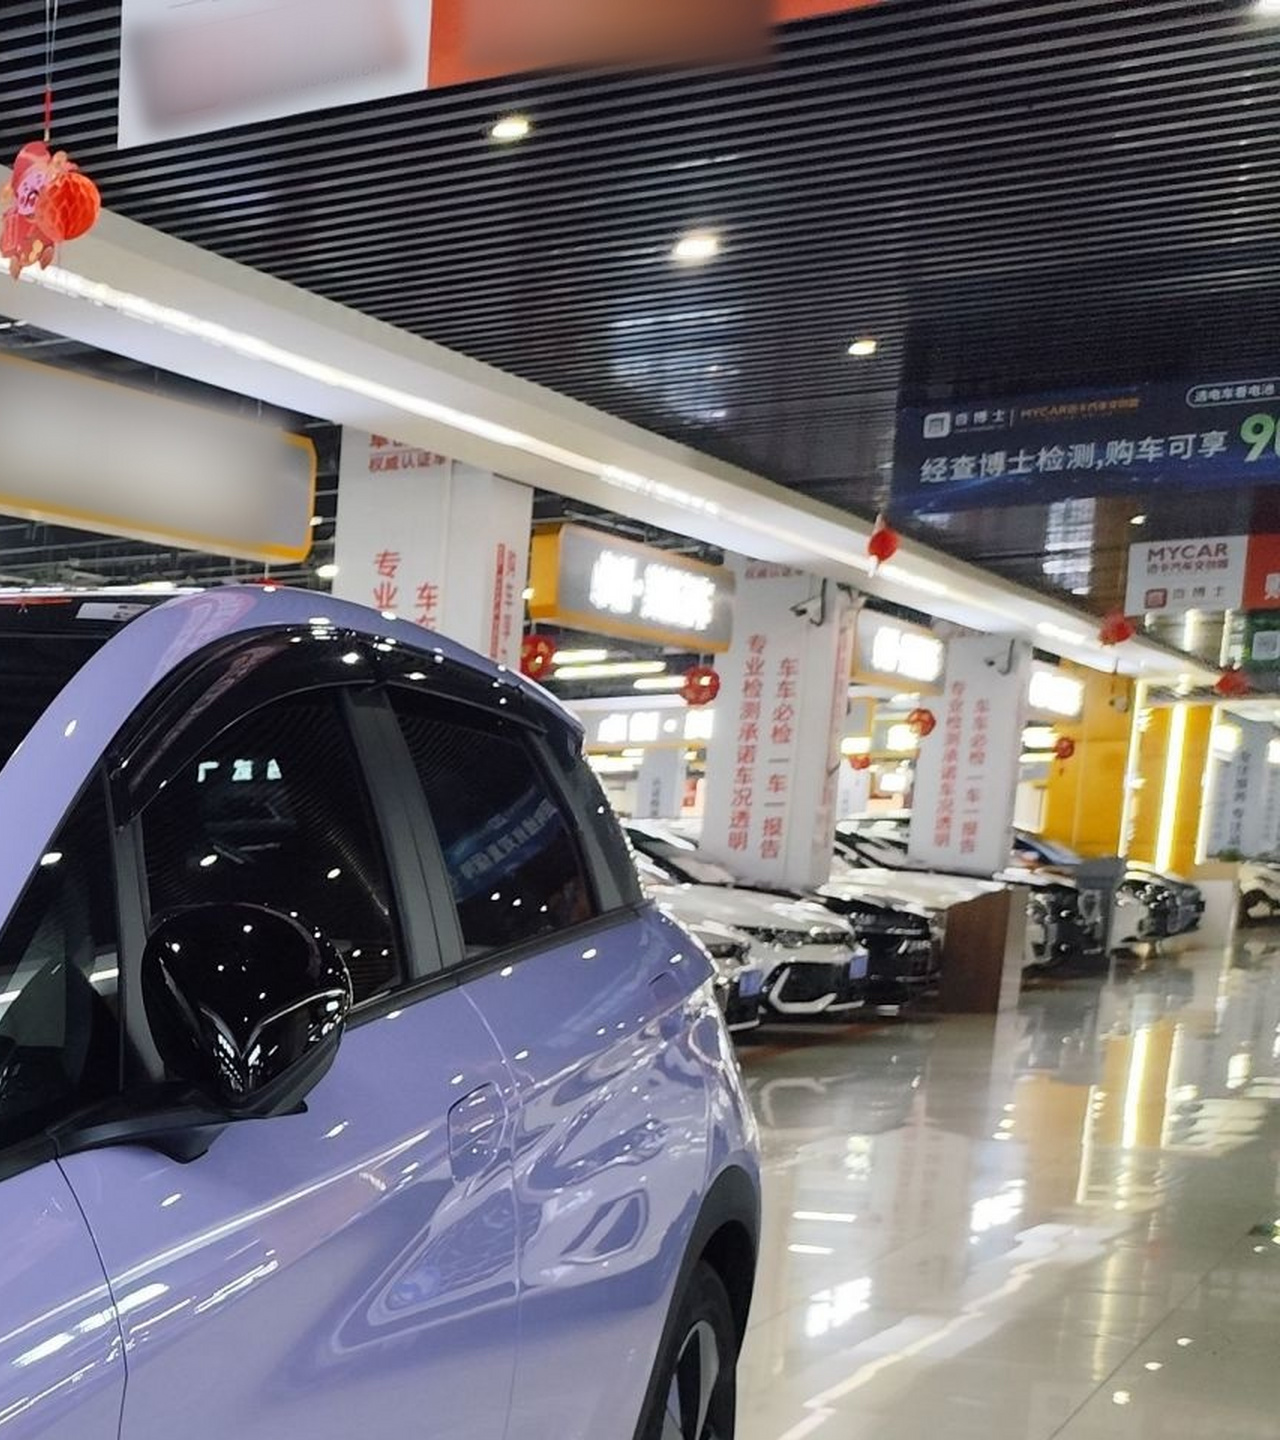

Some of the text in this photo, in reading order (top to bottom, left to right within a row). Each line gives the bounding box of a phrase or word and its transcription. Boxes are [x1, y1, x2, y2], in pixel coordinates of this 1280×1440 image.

[1241, 413, 1280, 463] 9
[1147, 543, 1228, 562] MYCAR
[728, 634, 767, 851] 专业检测承诺车况透明
[760, 657, 799, 860] 车车必检一车一报告
